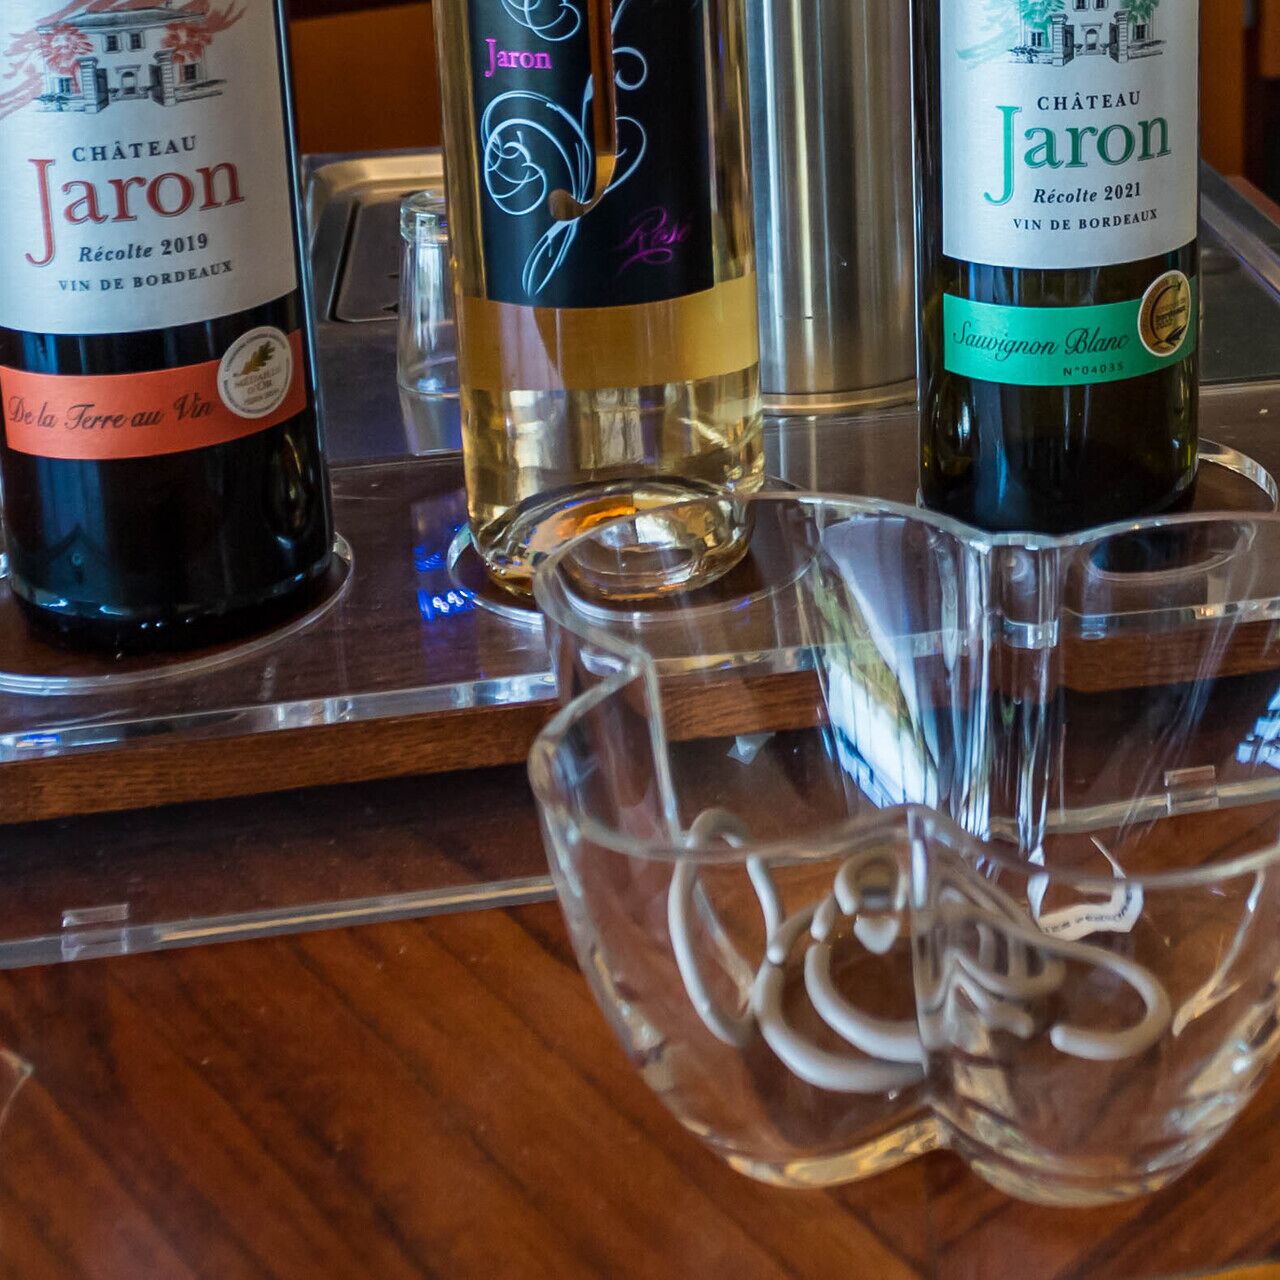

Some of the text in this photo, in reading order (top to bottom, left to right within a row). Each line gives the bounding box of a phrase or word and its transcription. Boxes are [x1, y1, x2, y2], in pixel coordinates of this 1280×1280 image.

[483, 37, 553, 78] Jaron
[1037, 90, 1141, 111] CHÂTEAU
[71, 134, 198, 163] CHÂTEAU
[983, 105, 1172, 207] Jaron
[1033, 181, 1141, 204] Récolte 2021
[24, 158, 246, 267] Jaron
[1013, 208, 1159, 231] VIN DE BORDEAUX
[78, 232, 209, 263] Récolte 2019
[58, 260, 234, 292] VIN DE BORDEAUX
[952, 320, 1130, 362] Sauvignon Blanc
[9, 392, 215, 431] De la Terre au Vin
